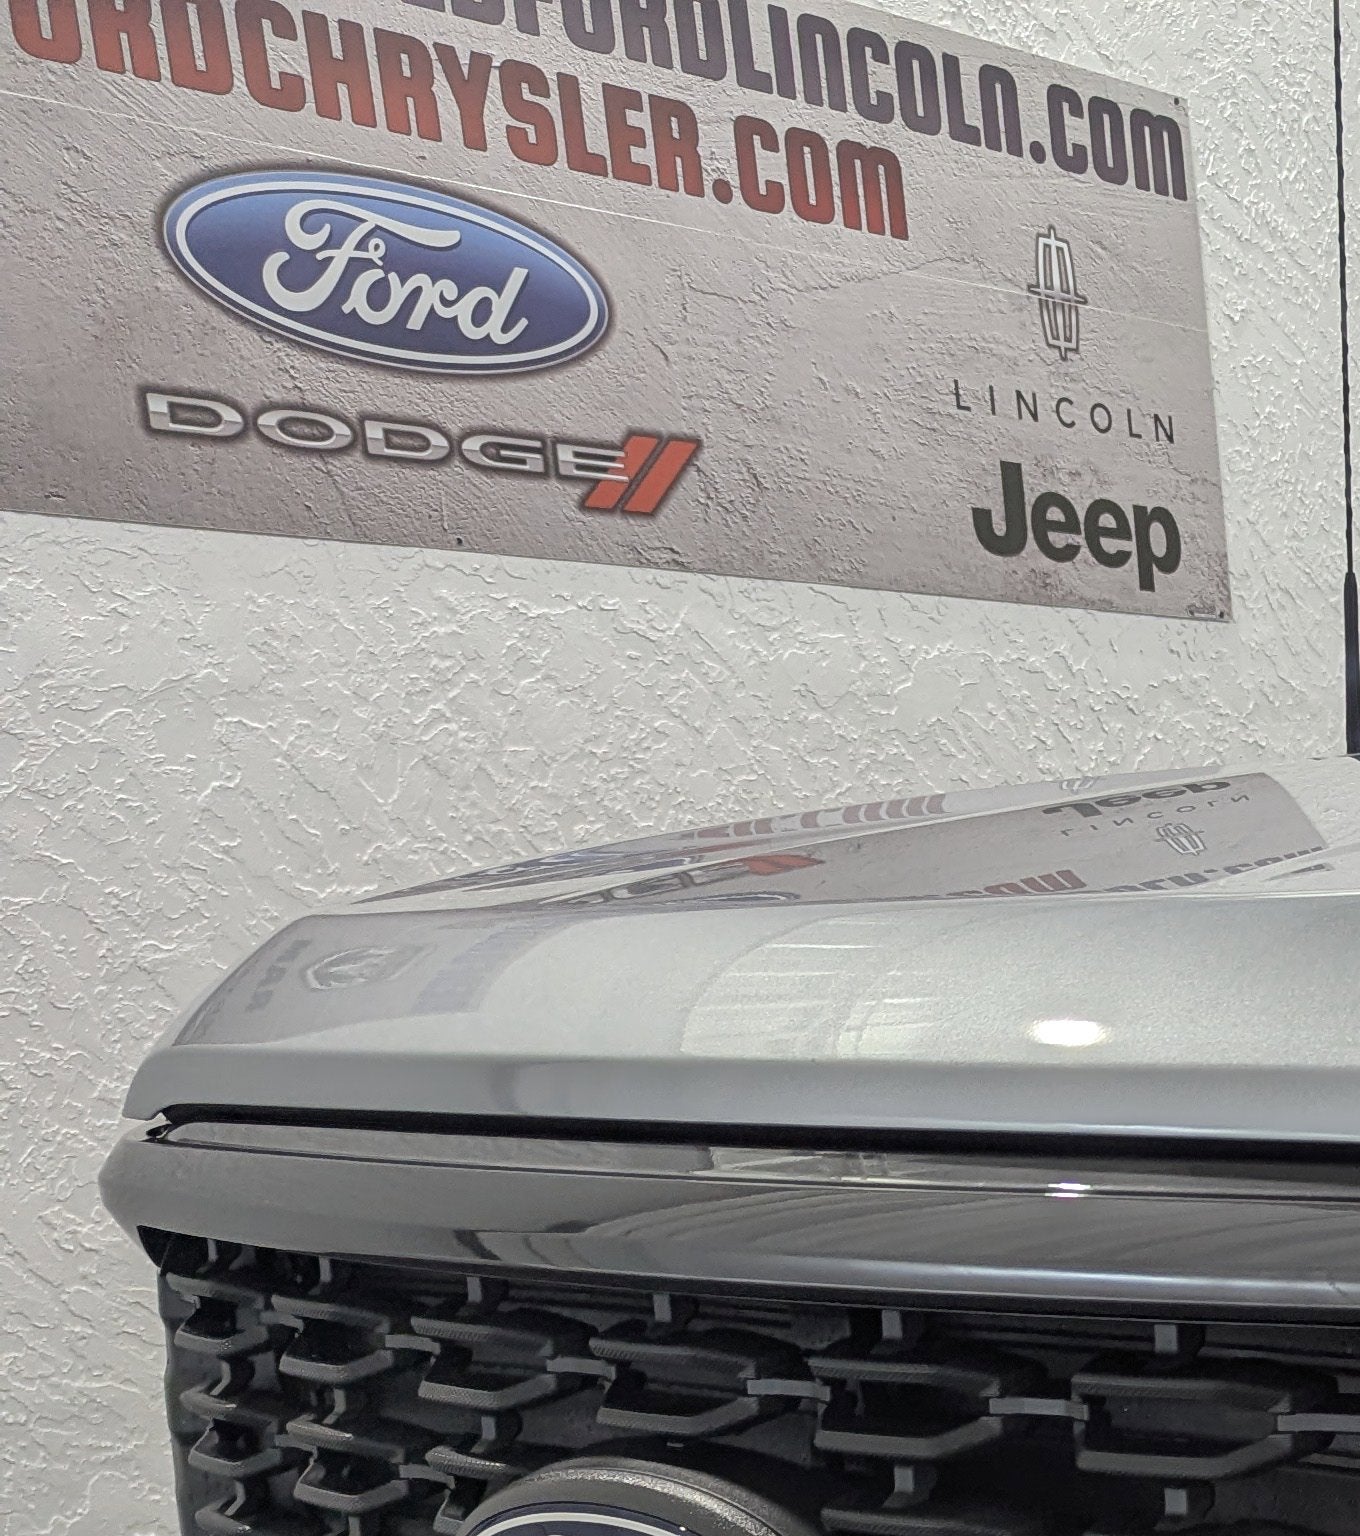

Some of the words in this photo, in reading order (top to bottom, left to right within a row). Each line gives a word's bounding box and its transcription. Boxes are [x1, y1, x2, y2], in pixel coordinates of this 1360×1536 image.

[400, 0, 1188, 201] RDLINCOLN.COM
[262, 199, 529, 345] Ford
[145, 391, 630, 483] DODGE
[953, 379, 1176, 444] LINCOLN
[971, 460, 1182, 592] Jeep
